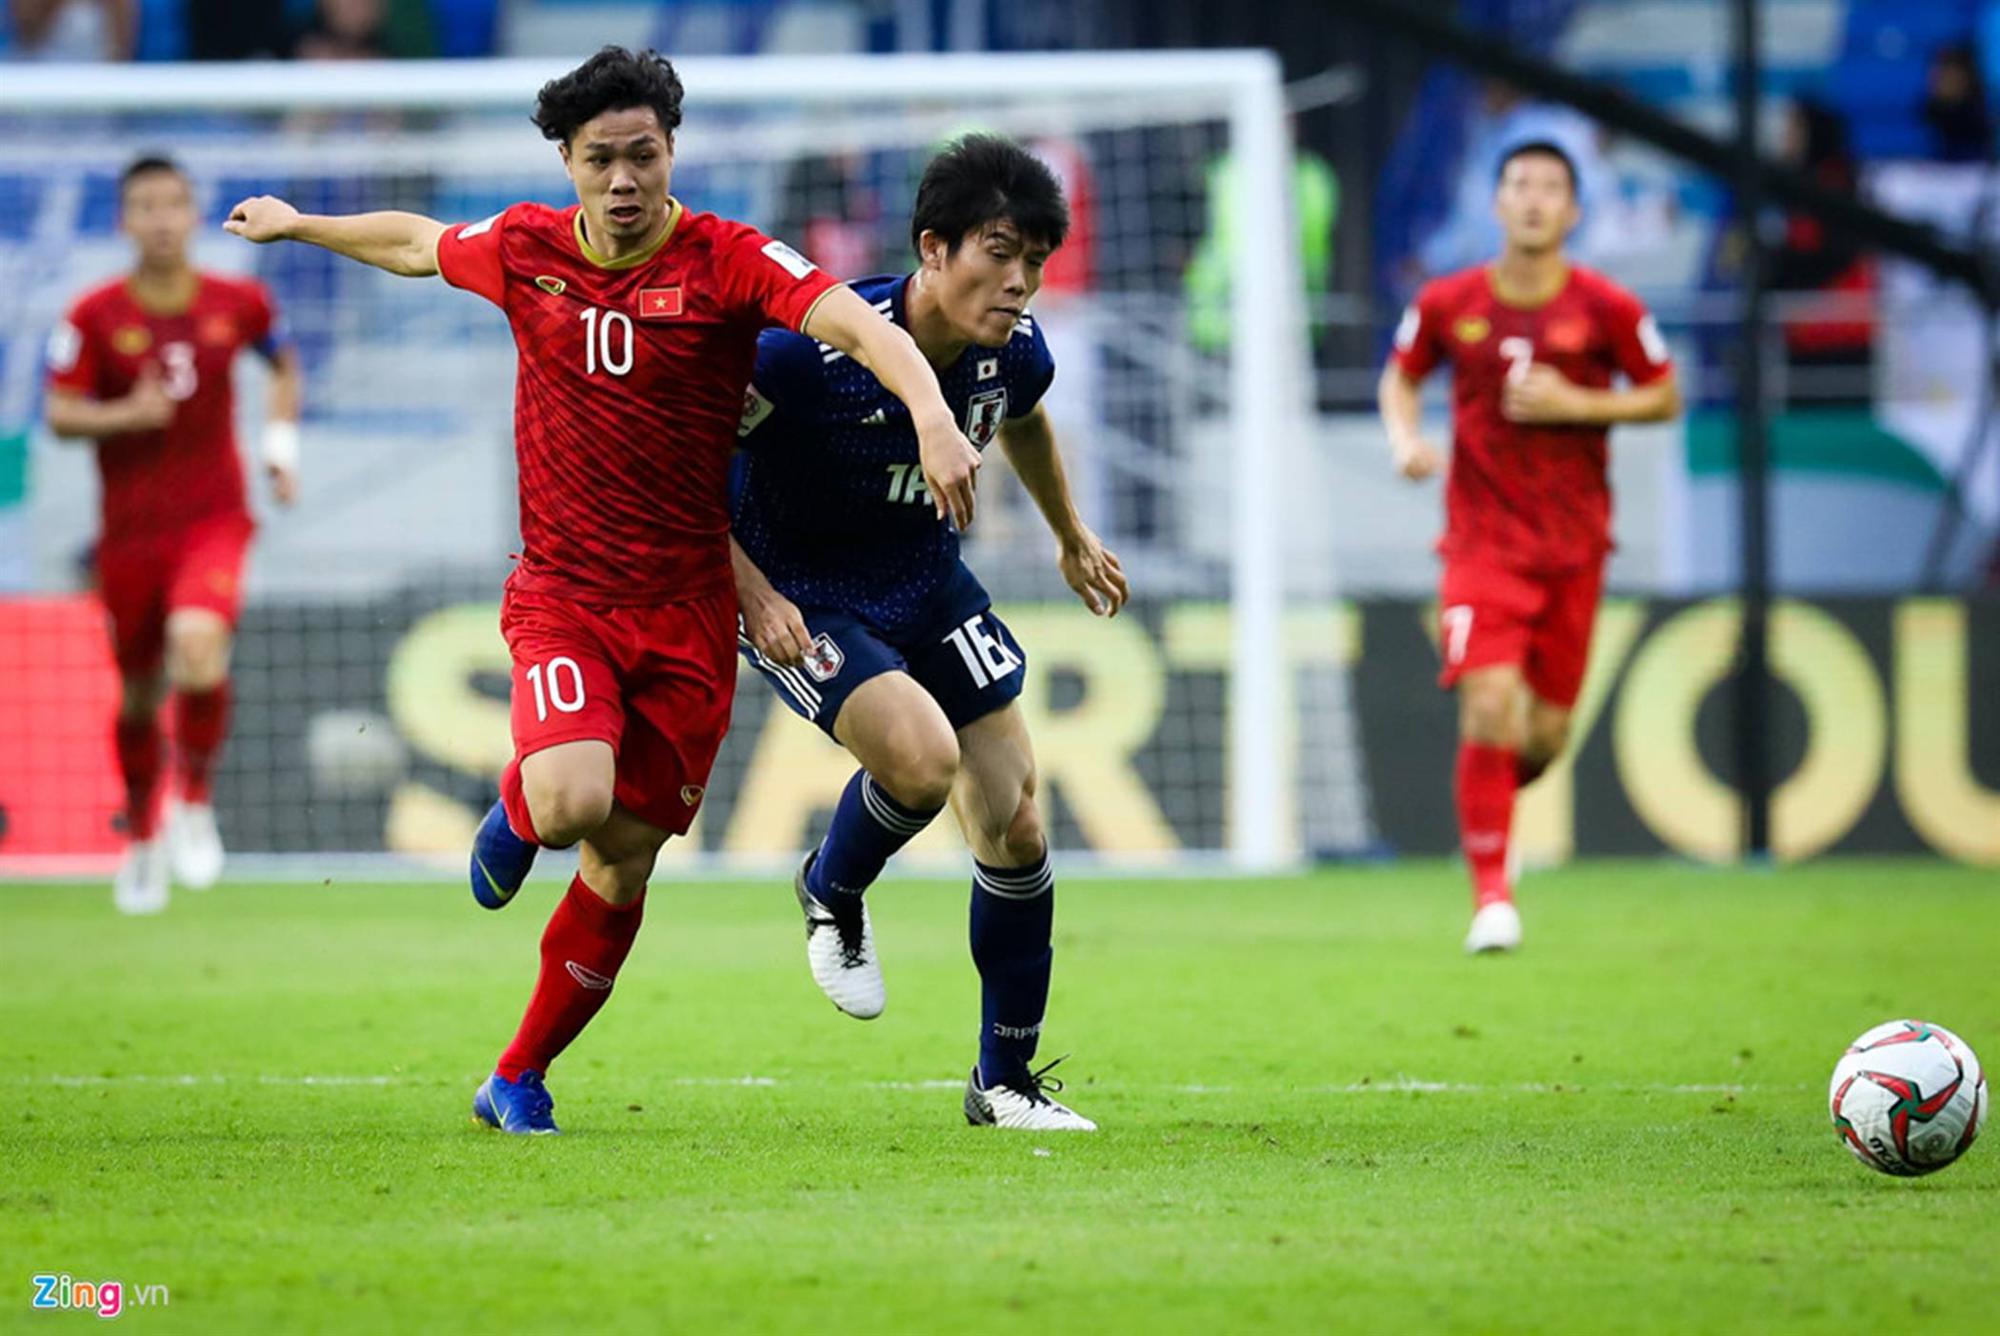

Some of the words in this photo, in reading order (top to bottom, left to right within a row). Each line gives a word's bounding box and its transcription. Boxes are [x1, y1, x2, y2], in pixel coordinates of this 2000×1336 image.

[160, 340, 198, 401] 3
[580, 306, 634, 376] 10
[941, 613, 1023, 689] 16
[1442, 604, 1475, 667] 7
[526, 655, 586, 723] 10
